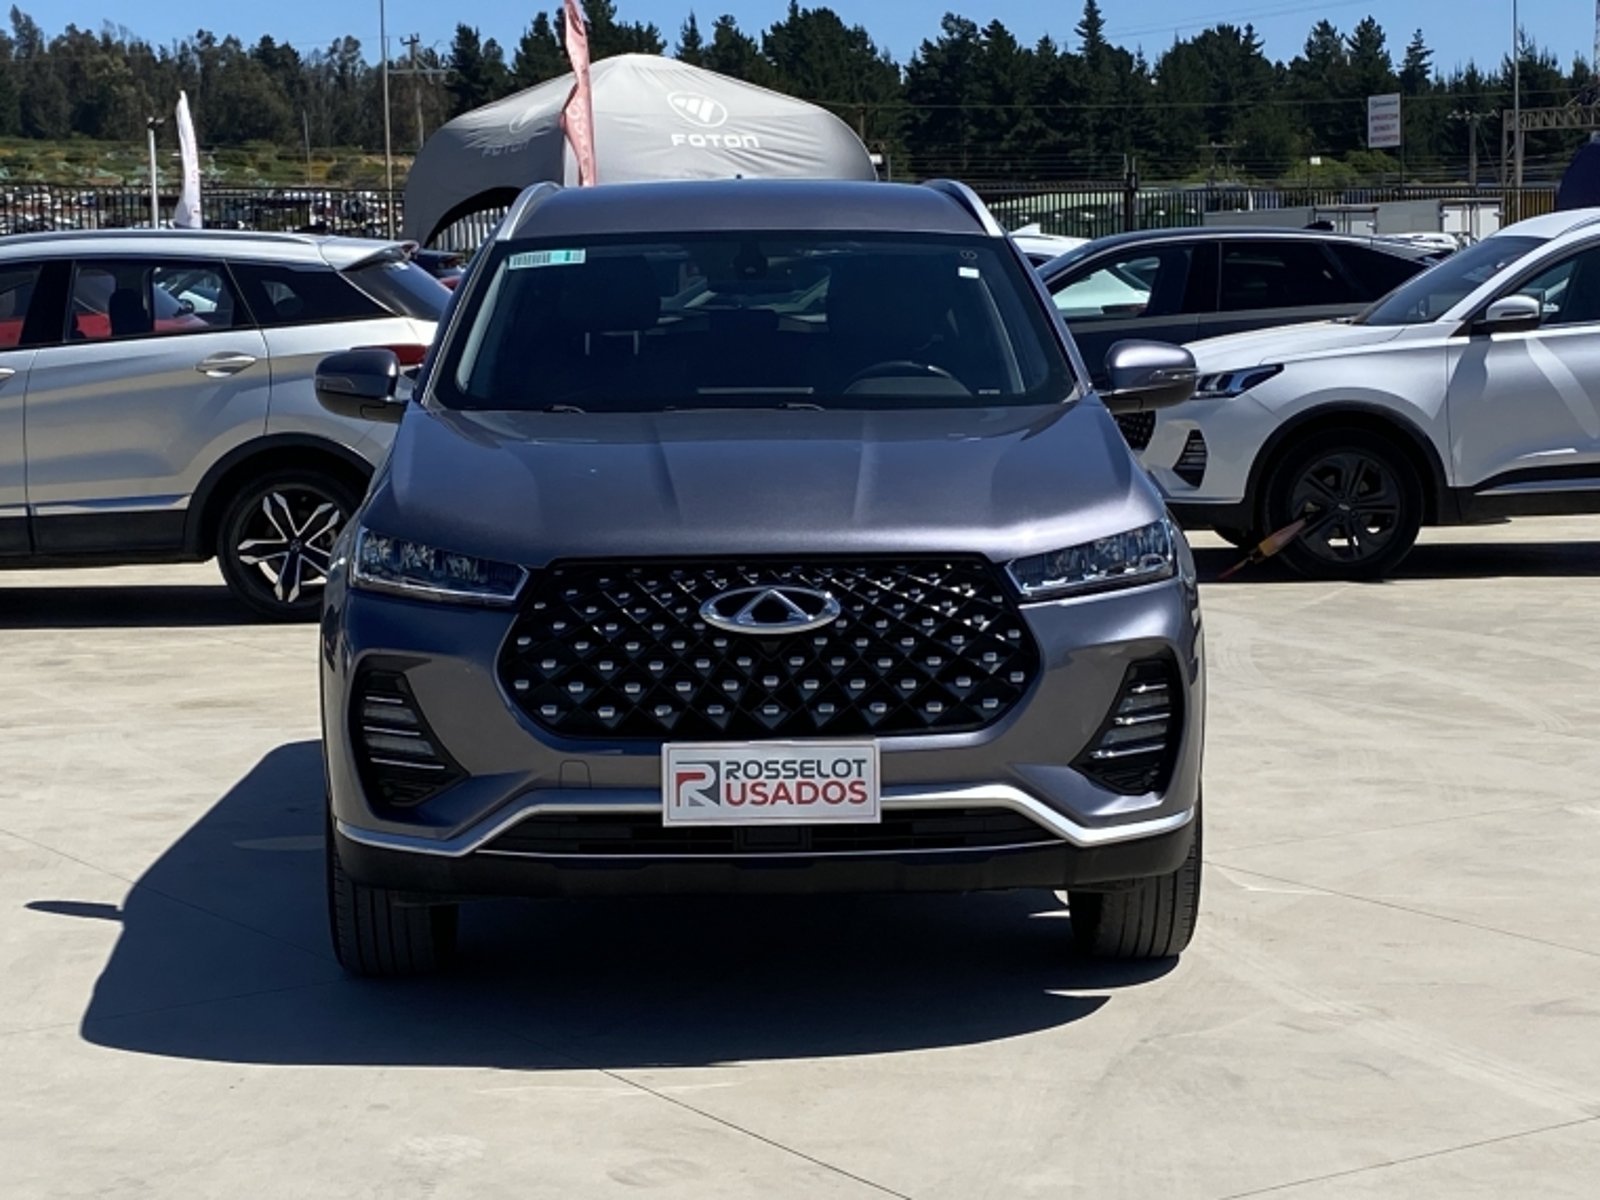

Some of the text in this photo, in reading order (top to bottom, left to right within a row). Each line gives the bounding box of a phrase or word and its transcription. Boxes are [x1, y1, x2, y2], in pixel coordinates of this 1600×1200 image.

[671, 134, 760, 148] FOTON
[725, 759, 867, 779] ROSSELOT
[726, 780, 868, 806] USADOS
